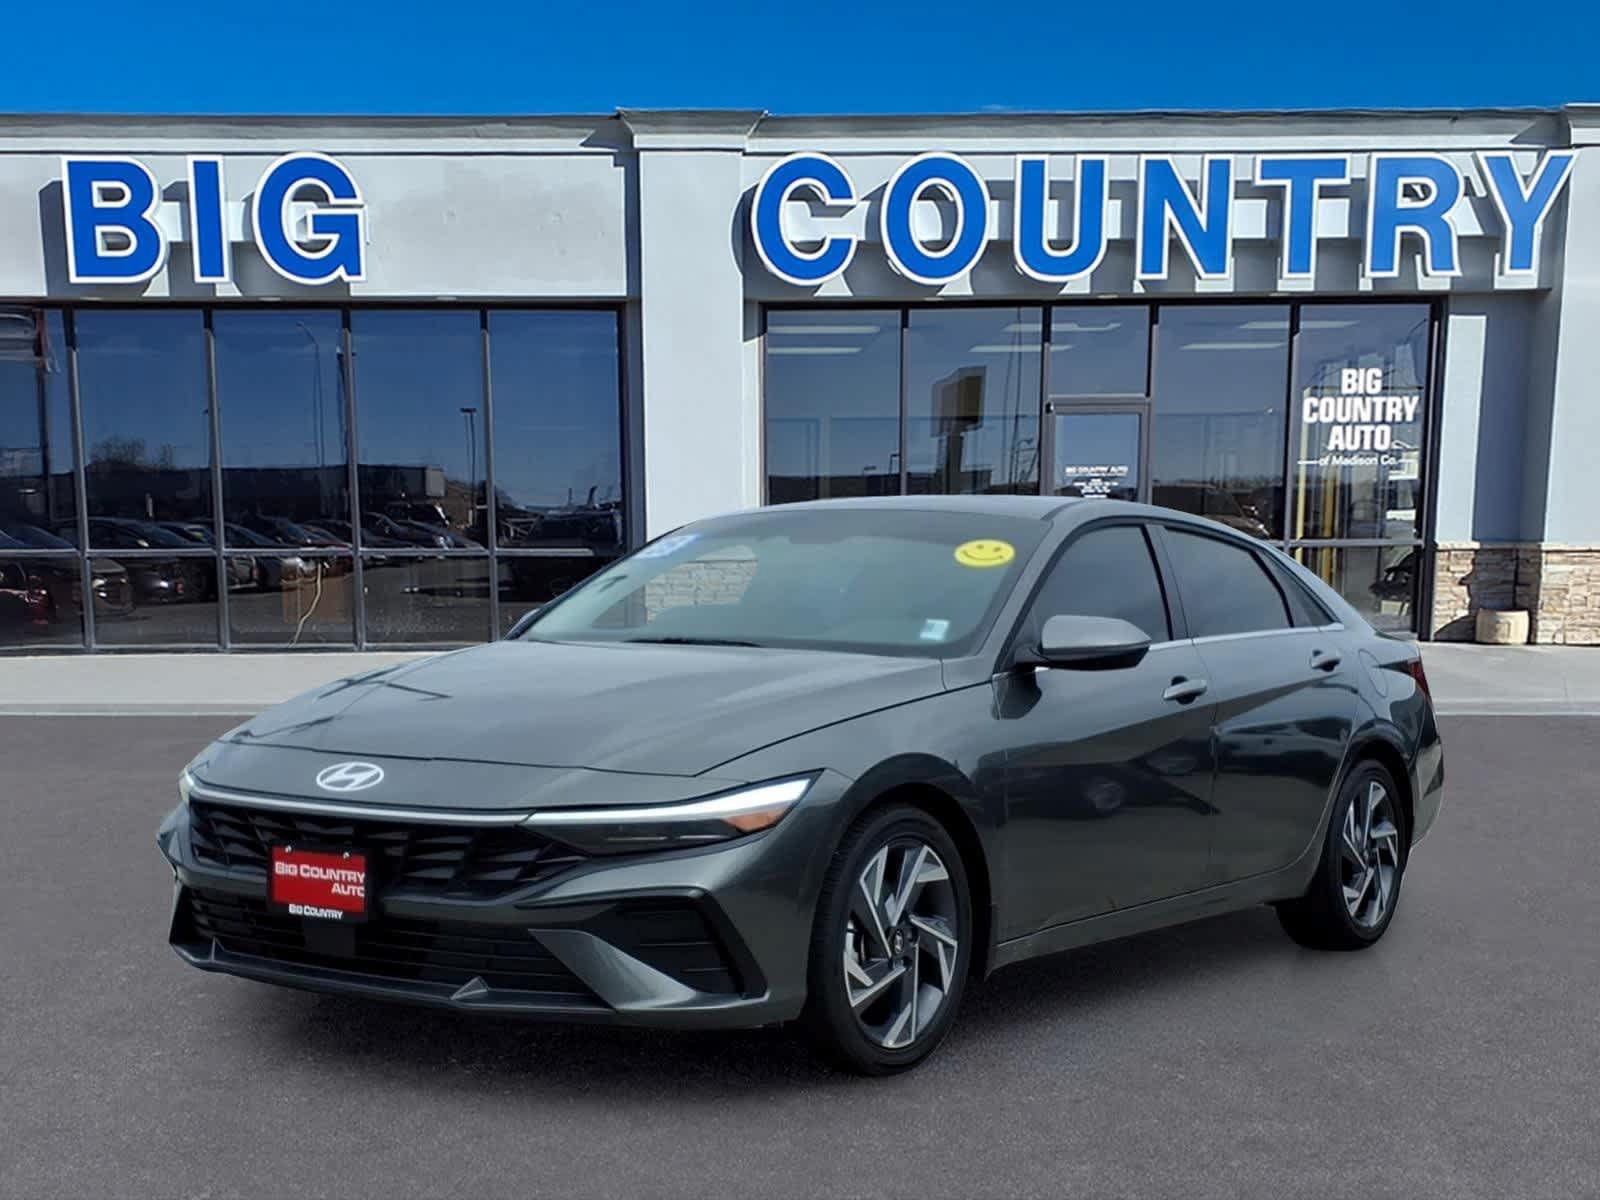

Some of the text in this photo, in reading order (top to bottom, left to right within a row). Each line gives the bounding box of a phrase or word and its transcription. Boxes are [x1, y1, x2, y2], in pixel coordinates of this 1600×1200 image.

[61, 151, 1574, 287] BIG COUNTRY
[1341, 367, 1382, 395] BIG
[1302, 396, 1420, 423] COUNTRY
[1327, 424, 1391, 451] AUTO
[1318, 455, 1330, 466] of
[1331, 455, 1378, 465] Madison
[275, 861, 366, 883] BIG COUNTRY
[303, 905, 344, 920] COUNTRY
